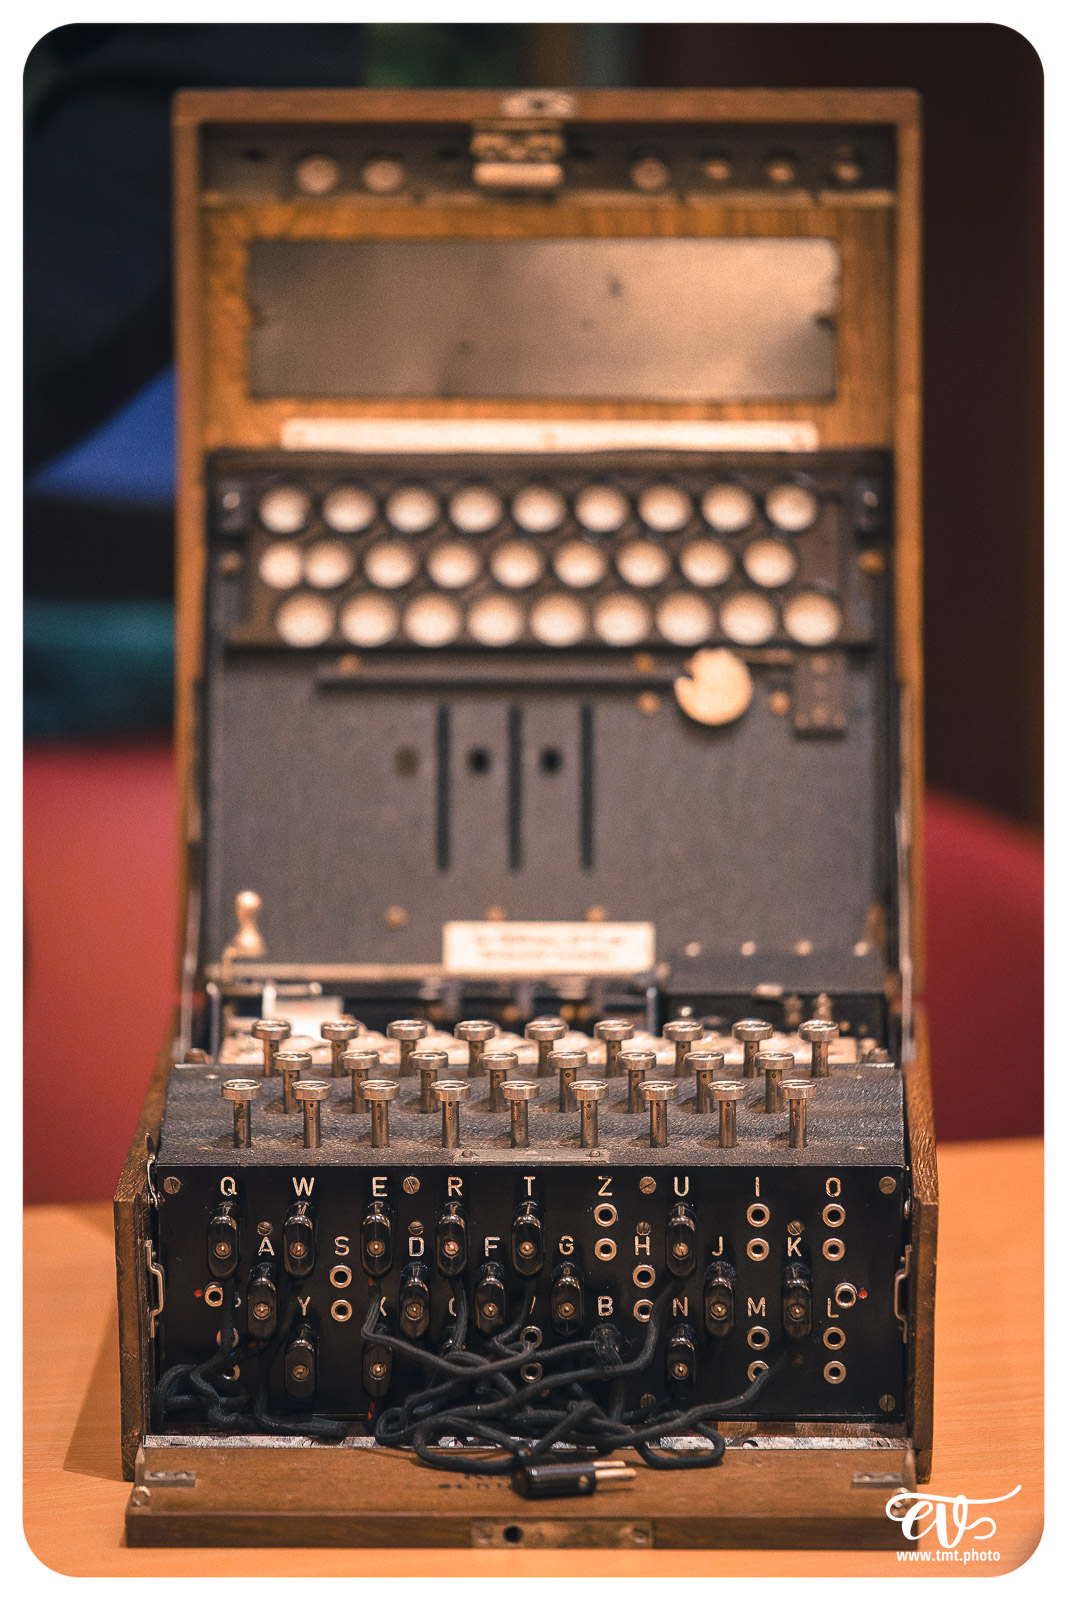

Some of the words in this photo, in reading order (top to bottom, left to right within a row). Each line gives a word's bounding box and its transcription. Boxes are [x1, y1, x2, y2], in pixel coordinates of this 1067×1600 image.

[220, 1177, 238, 1197] Q
[292, 1177, 315, 1197] W
[372, 1177, 388, 1197] E
[447, 1177, 463, 1197] R
[523, 1177, 536, 1196] T
[597, 1176, 613, 1197] Z
[673, 1177, 689, 1197] U
[825, 1177, 842, 1197] O
[258, 1236, 275, 1256] A
[334, 1236, 350, 1256] S
[408, 1237, 425, 1257] D
[484, 1236, 501, 1256] F
[558, 1235, 575, 1256] G
[634, 1236, 651, 1256] H
[711, 1236, 724, 1257] J
[787, 1236, 803, 1257] K
[297, 1296, 312, 1316] Y
[597, 1296, 614, 1317] B
[672, 1296, 689, 1317] N
[747, 1296, 767, 1317] M
[827, 1297, 840, 1318] L
